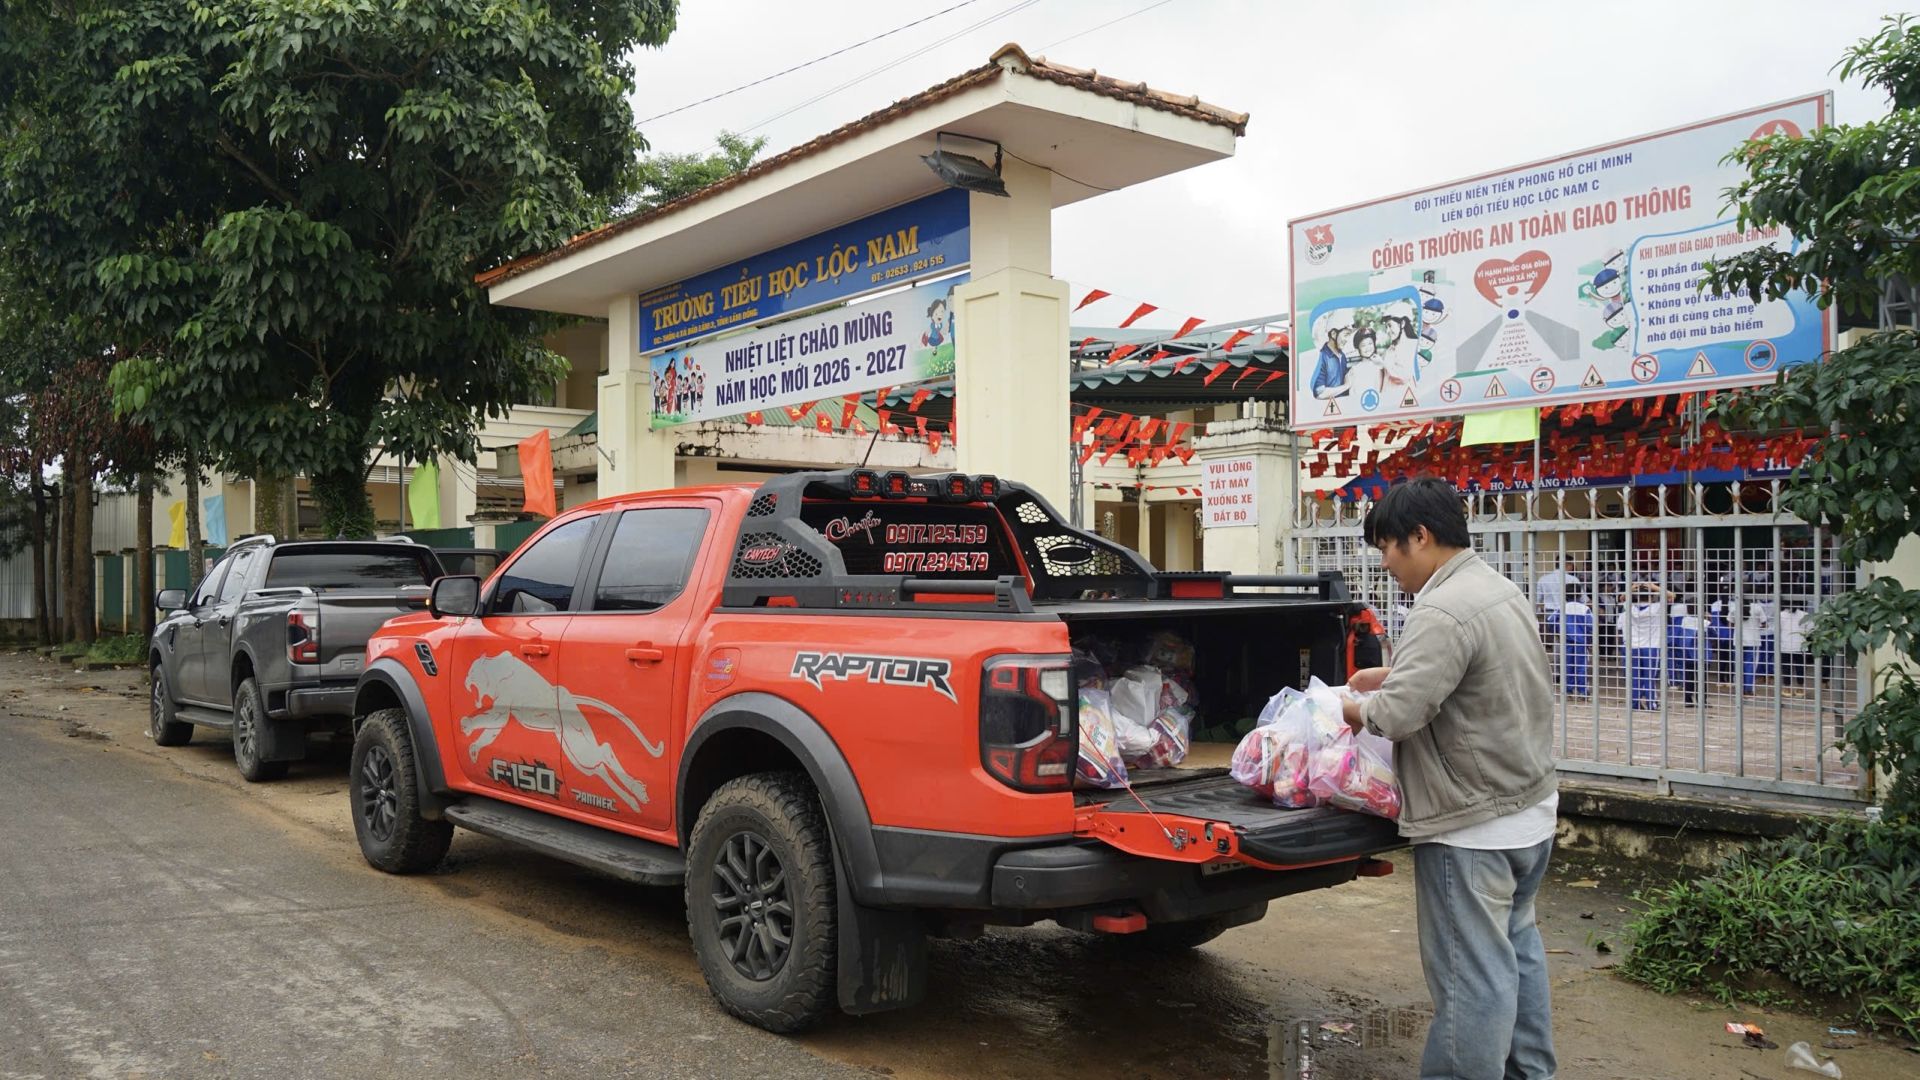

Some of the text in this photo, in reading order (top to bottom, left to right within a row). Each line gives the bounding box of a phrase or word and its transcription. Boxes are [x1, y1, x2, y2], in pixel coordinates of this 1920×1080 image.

[1518, 170, 1555, 189] PHONG
[1602, 152, 1632, 170] MINH
[1513, 193, 1535, 209] HỌC
[1563, 182, 1588, 197] NAM
[1592, 178, 1600, 191] C
[1372, 185, 1691, 269] CỔNG TRƯỜNG AN TOÀN GIAO THÔNG
[1640, 247, 1652, 260] KHI
[1655, 242, 1676, 258] THAM
[1679, 240, 1692, 254] GIA
[1695, 237, 1714, 251] GIAO
[768, 262, 808, 300] HỌC
[816, 243, 859, 284] LỘC
[866, 225, 920, 268] NAM
[1648, 282, 1680, 294] Không
[1648, 298, 1681, 310] Không
[1648, 314, 1666, 326] Khi
[1669, 313, 1679, 324] đi
[1712, 306, 1733, 318] cha
[726, 310, 893, 373] NHIỆT LIỆT CHÀO MỪNG
[716, 378, 746, 406] NĂM
[750, 374, 776, 403] HỌC
[781, 362, 809, 394] MỚI
[814, 357, 850, 388] 2026
[866, 344, 907, 376] 2027
[1209, 464, 1225, 474] VUI
[1241, 494, 1252, 504] XE
[1234, 509, 1247, 522] BỘ
[886, 524, 988, 544] 0917.125.159
[744, 547, 781, 560] CANTECH
[884, 552, 988, 572] 0977.2345.79
[790, 651, 958, 704] RAPTOR
[492, 758, 556, 796] F-150
[571, 788, 619, 813] PANTHER
